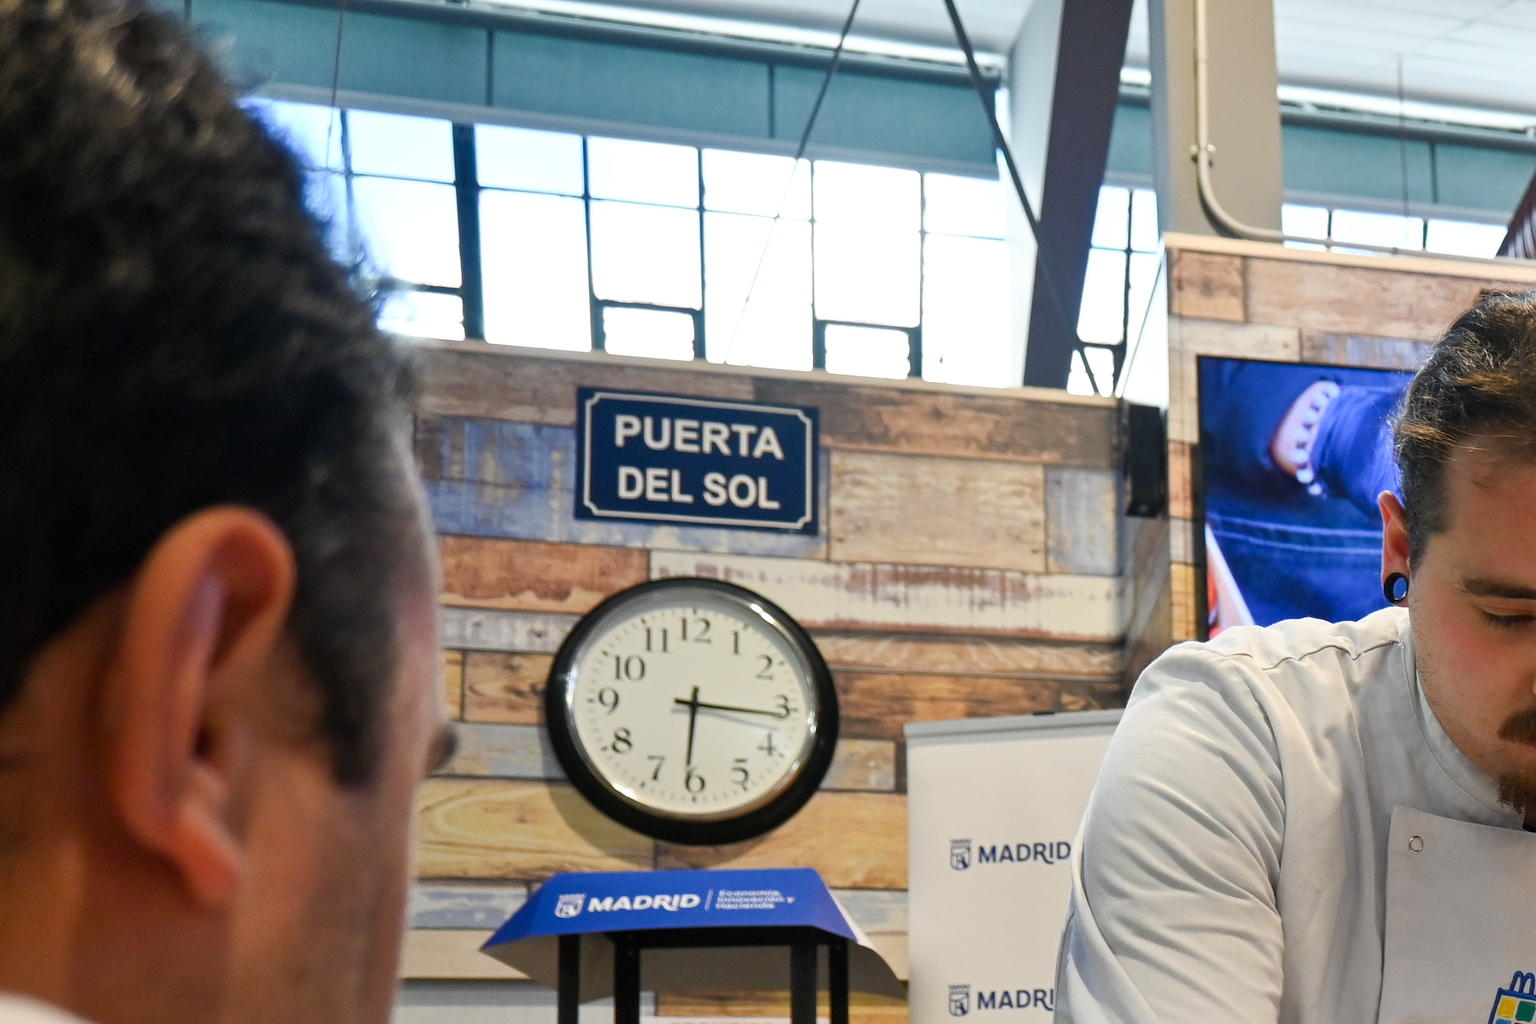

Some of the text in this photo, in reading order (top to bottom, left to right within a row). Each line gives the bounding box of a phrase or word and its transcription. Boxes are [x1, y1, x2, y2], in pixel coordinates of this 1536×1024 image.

[615, 414, 785, 460] PUERTA
[618, 465, 781, 510] DEL SOL
[645, 626, 669, 653] 11
[681, 617, 711, 644] 12
[733, 631, 740, 655] 1
[614, 654, 646, 681] 10
[755, 654, 774, 681] 2
[597, 687, 619, 715] 9
[772, 694, 790, 719] 3
[611, 727, 633, 755] 8
[757, 732, 776, 756] 4
[647, 755, 665, 781] 7
[684, 765, 705, 794] 6
[731, 758, 749, 786] 5
[978, 841, 1071, 865] MADRID
[587, 893, 701, 913] MADRID
